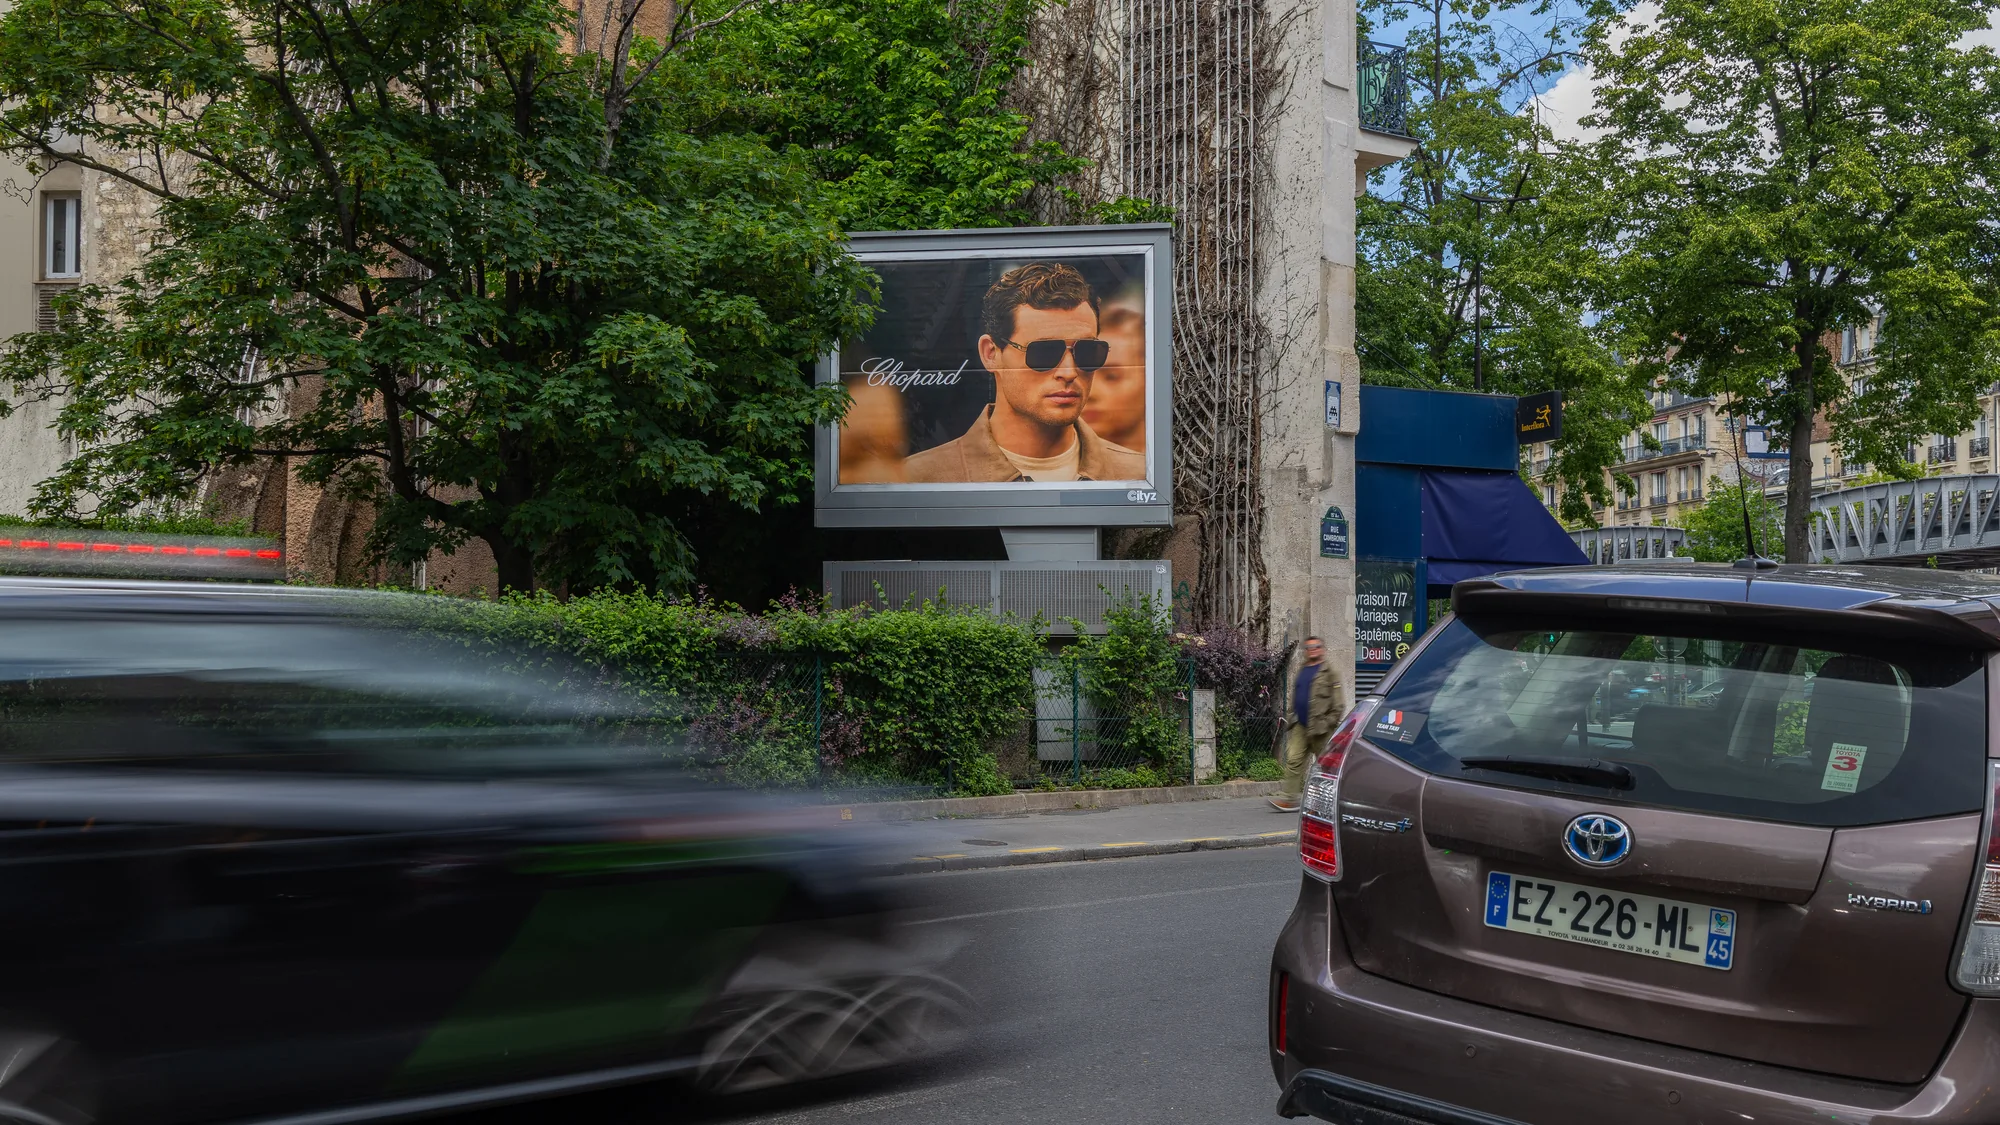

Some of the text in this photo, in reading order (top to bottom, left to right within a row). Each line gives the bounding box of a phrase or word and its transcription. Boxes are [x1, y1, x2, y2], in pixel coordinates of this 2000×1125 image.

[861, 357, 969, 393] Chopard
[1127, 490, 1157, 503] Cityz
[1323, 533, 1347, 543] CAMBRONNE
[1330, 526, 1339, 534] RUE
[1392, 591, 1408, 607] 7/7
[1355, 608, 1399, 626] Mariages
[1355, 627, 1402, 644] Baptêmes
[1361, 646, 1392, 660] Deuils
[1831, 755, 1858, 771] 3
[1847, 893, 1919, 912] HYBRID
[1493, 879, 1729, 960] F EZ-226-ML 45
[1548, 930, 1569, 939] TOYOTA
[1571, 934, 1609, 947] VILLEMANDEUR
[1627, 944, 1634, 952] 38
